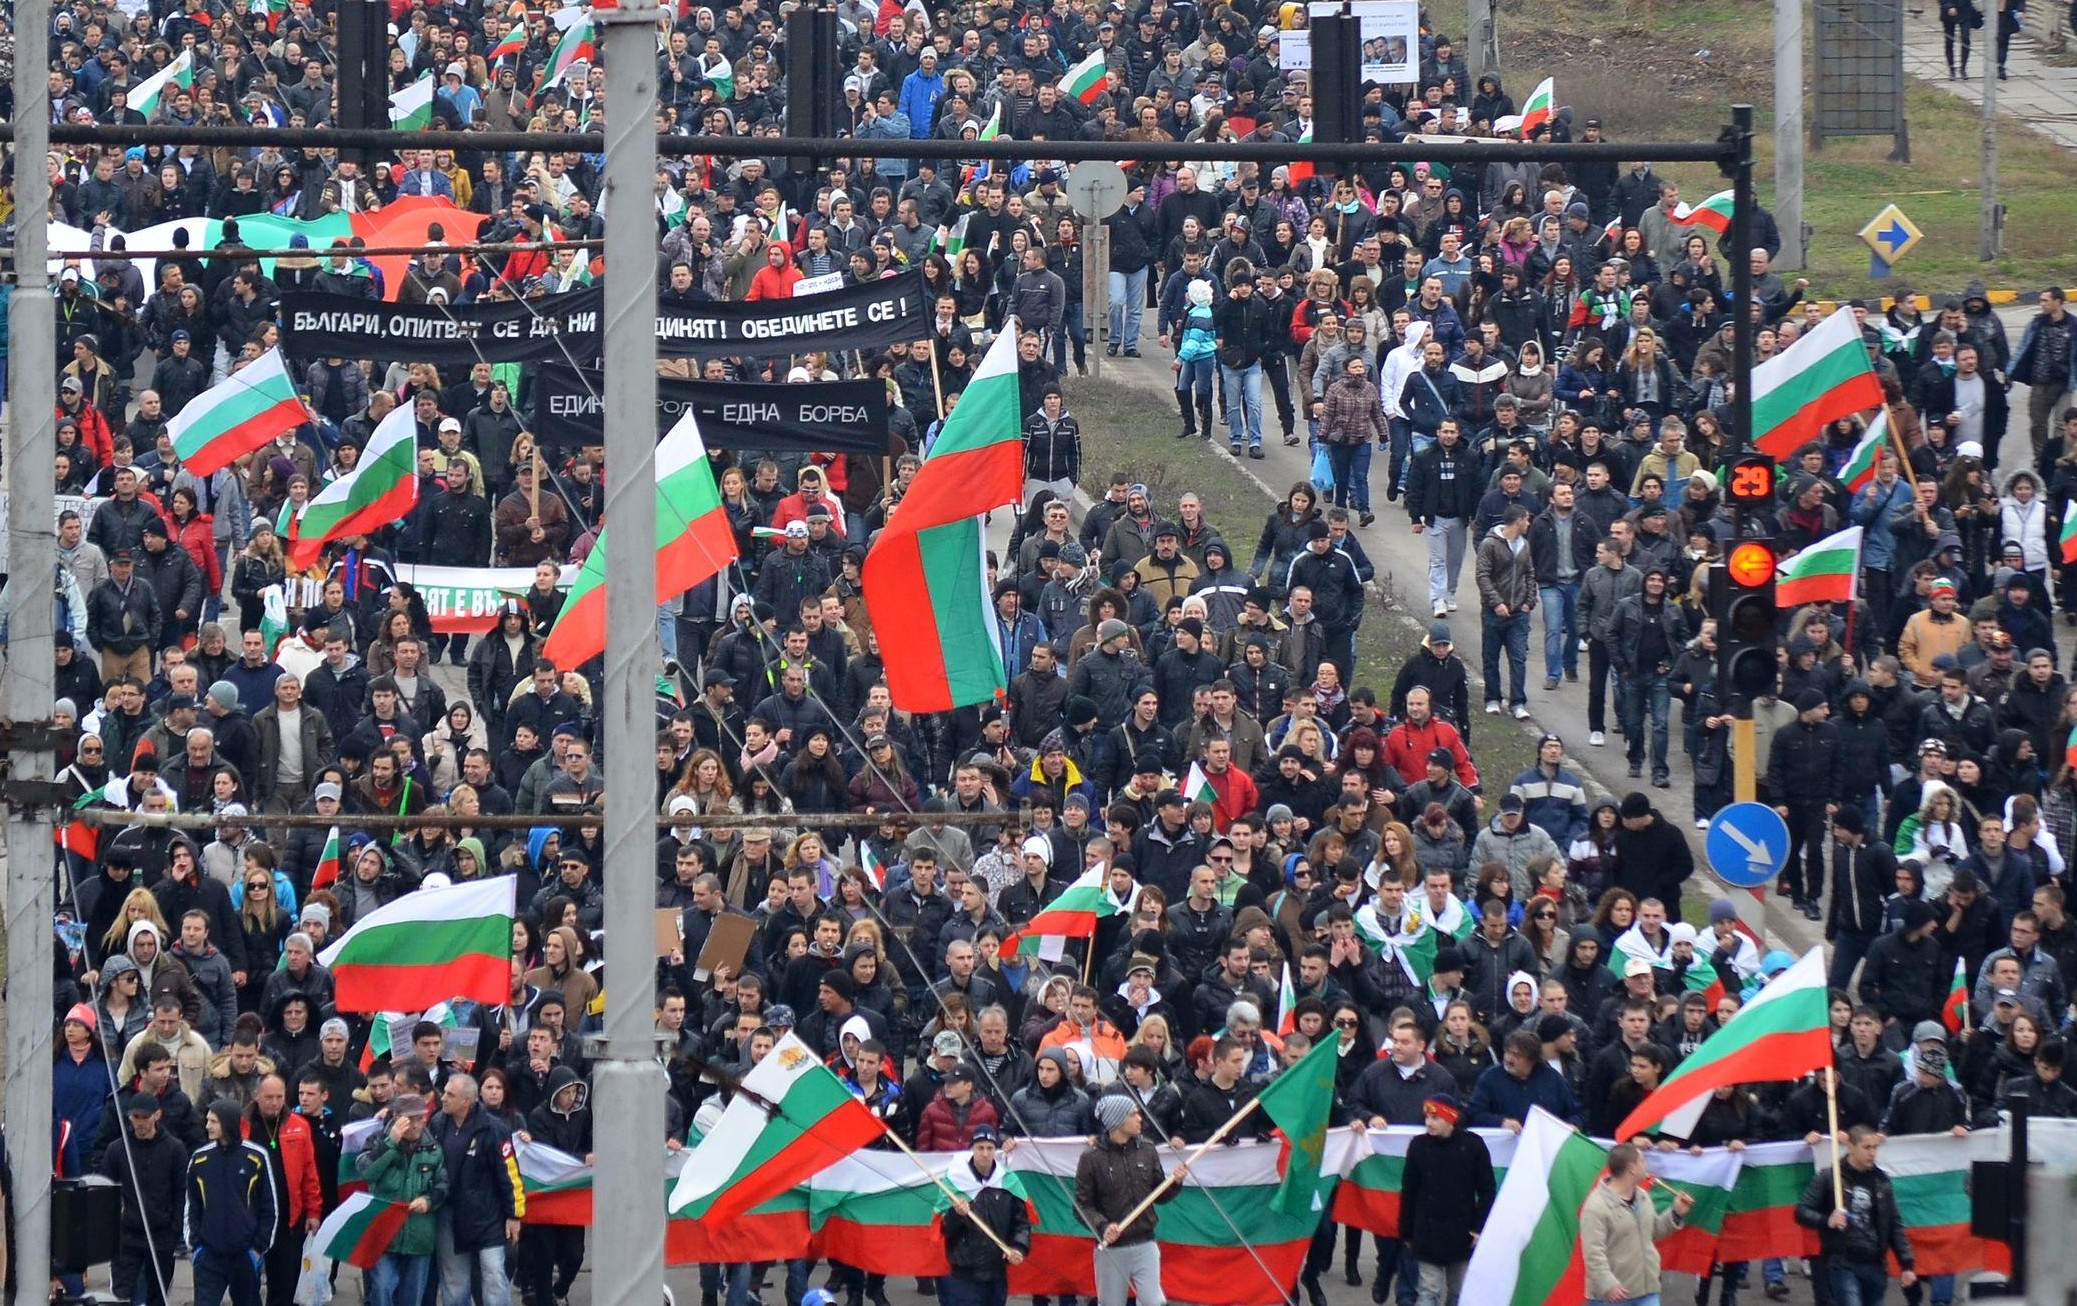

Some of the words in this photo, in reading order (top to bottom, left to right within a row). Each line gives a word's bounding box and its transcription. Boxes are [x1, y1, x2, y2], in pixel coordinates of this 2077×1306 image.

[493, 320, 520, 338] СЕ
[568, 311, 597, 333] НИ
[654, 317, 727, 340] ДИНЯТ!
[741, 307, 858, 339] ОБЕДИНЕТЕ
[723, 403, 780, 425] ЕДНА
[799, 404, 868, 423] БОРБА
